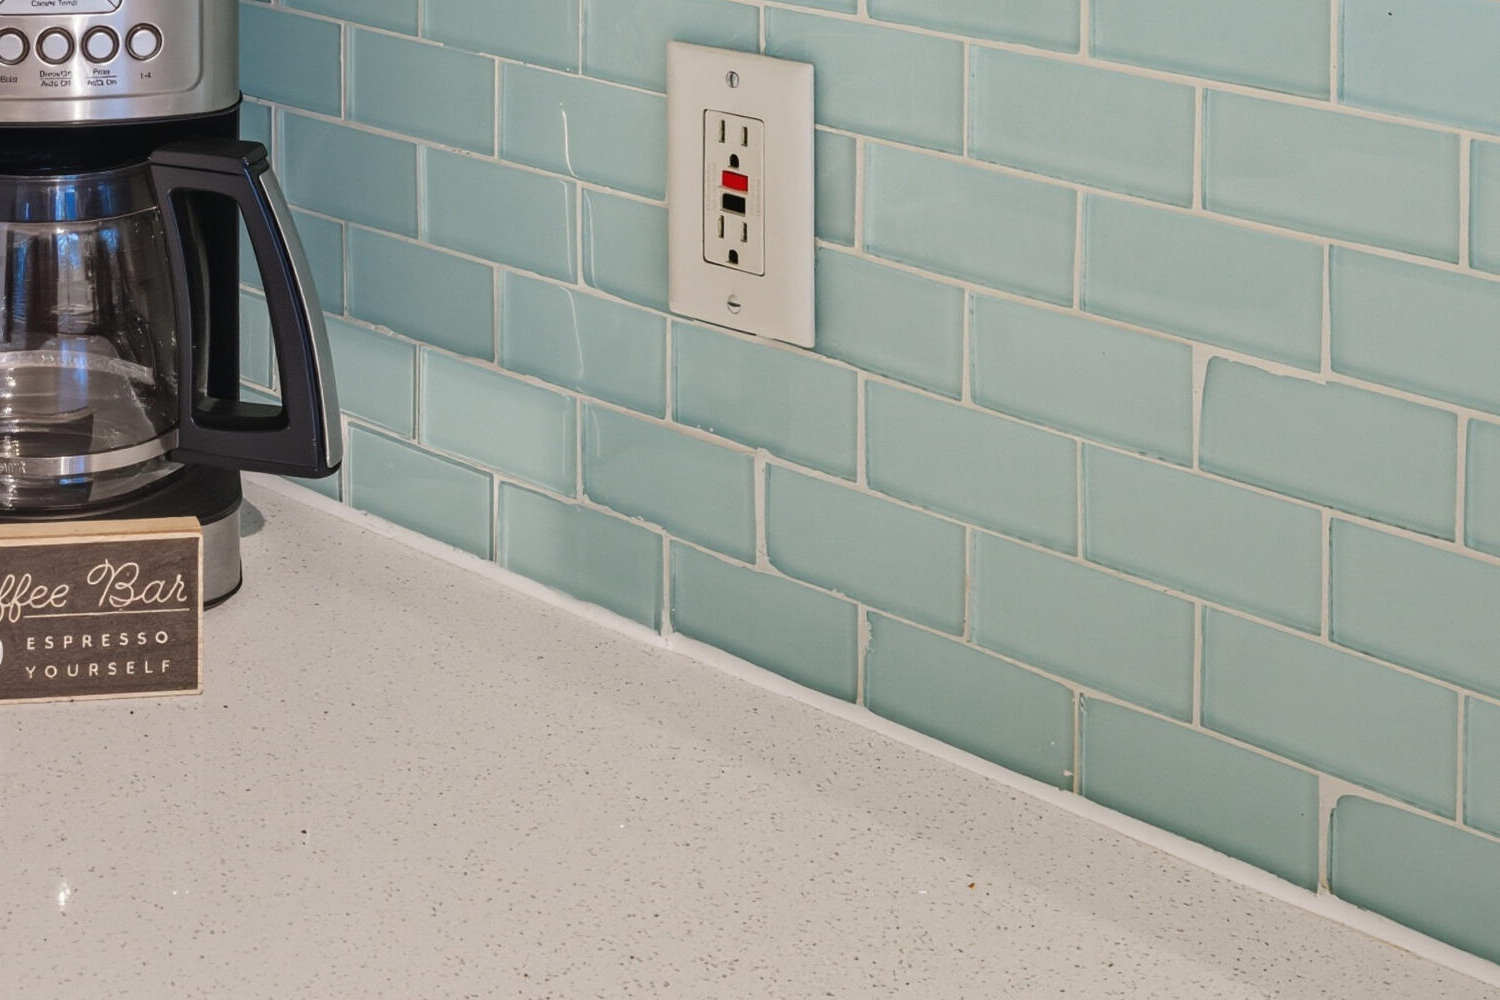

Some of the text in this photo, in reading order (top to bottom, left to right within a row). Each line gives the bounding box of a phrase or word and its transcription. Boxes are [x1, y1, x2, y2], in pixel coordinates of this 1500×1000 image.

[86, 558, 188, 609] Bar
[26, 630, 169, 651] ESPRESSO
[25, 659, 171, 680] YOURSELF
